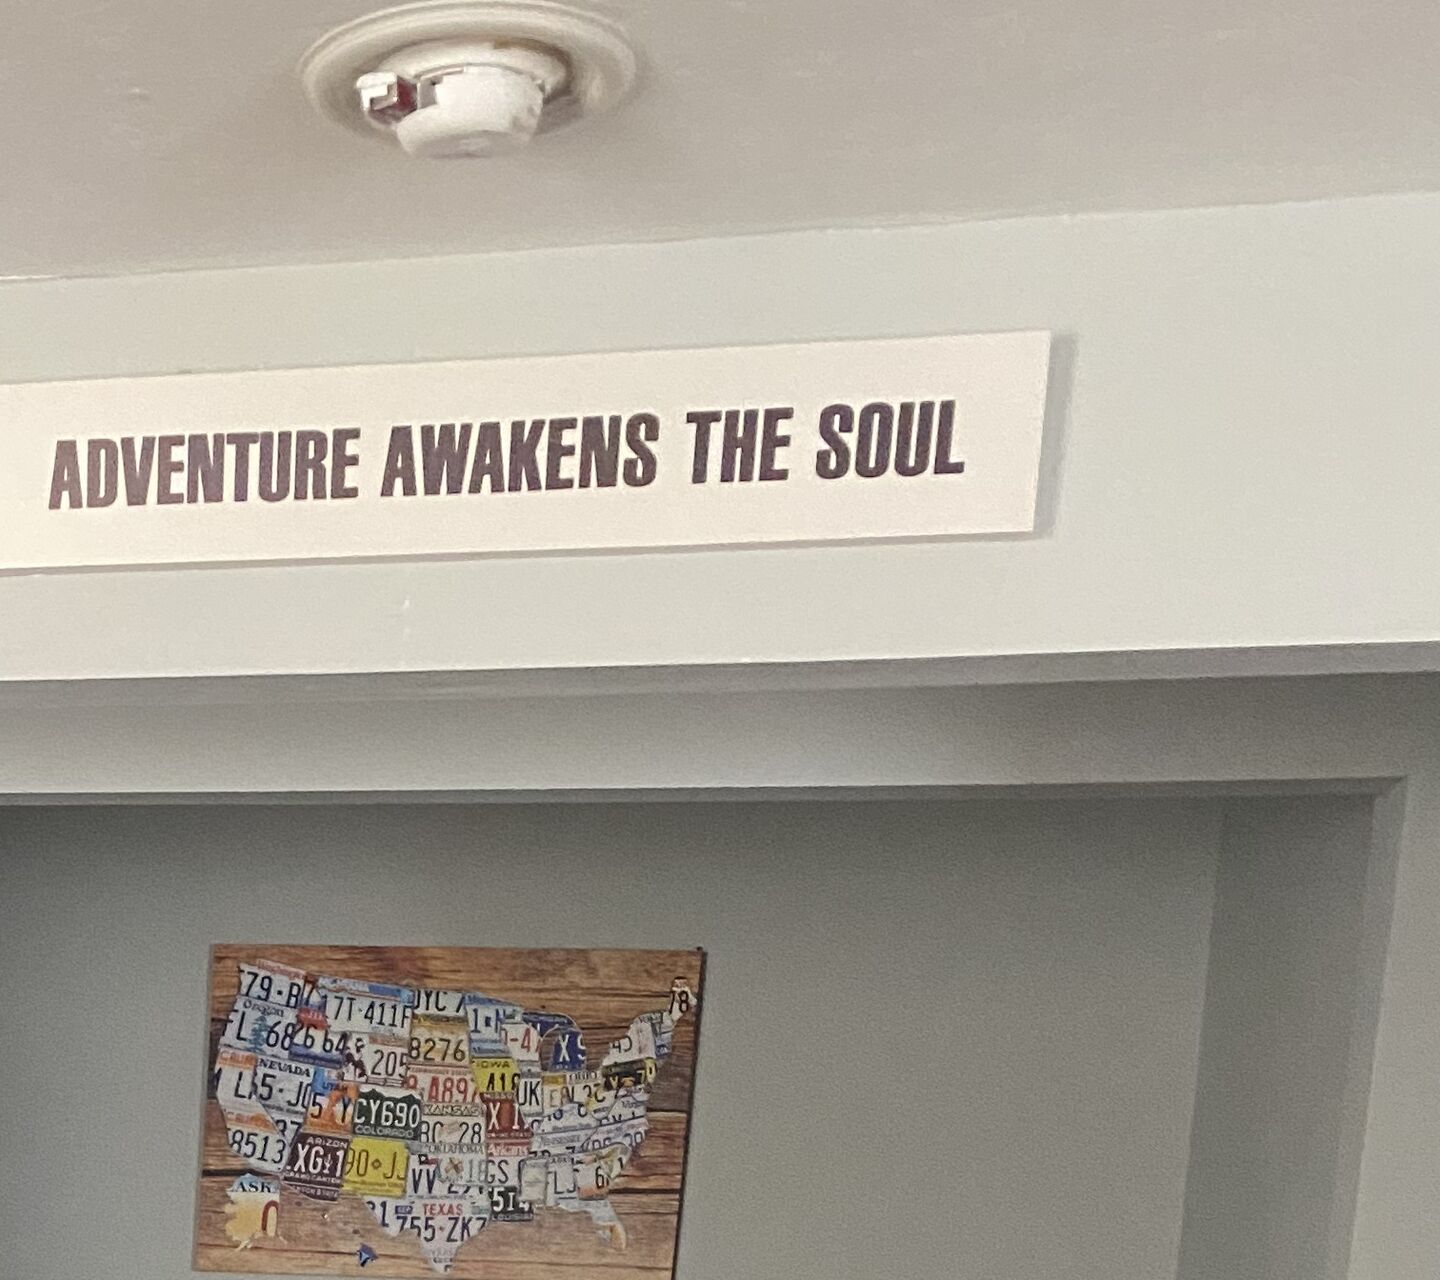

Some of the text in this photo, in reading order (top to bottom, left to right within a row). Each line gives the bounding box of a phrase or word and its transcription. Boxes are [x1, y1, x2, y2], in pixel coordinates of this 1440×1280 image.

[48, 400, 965, 511] ADVENTURE AWAKENS THE SOUL
[409, 1037, 466, 1062] 8276
[259, 1058, 311, 1078] NEVADA
[354, 1099, 420, 1128] CY690
[424, 1104, 479, 1116] KANSAS
[355, 1125, 414, 1138] COLORADO
[423, 1203, 464, 1217] TEXAS
